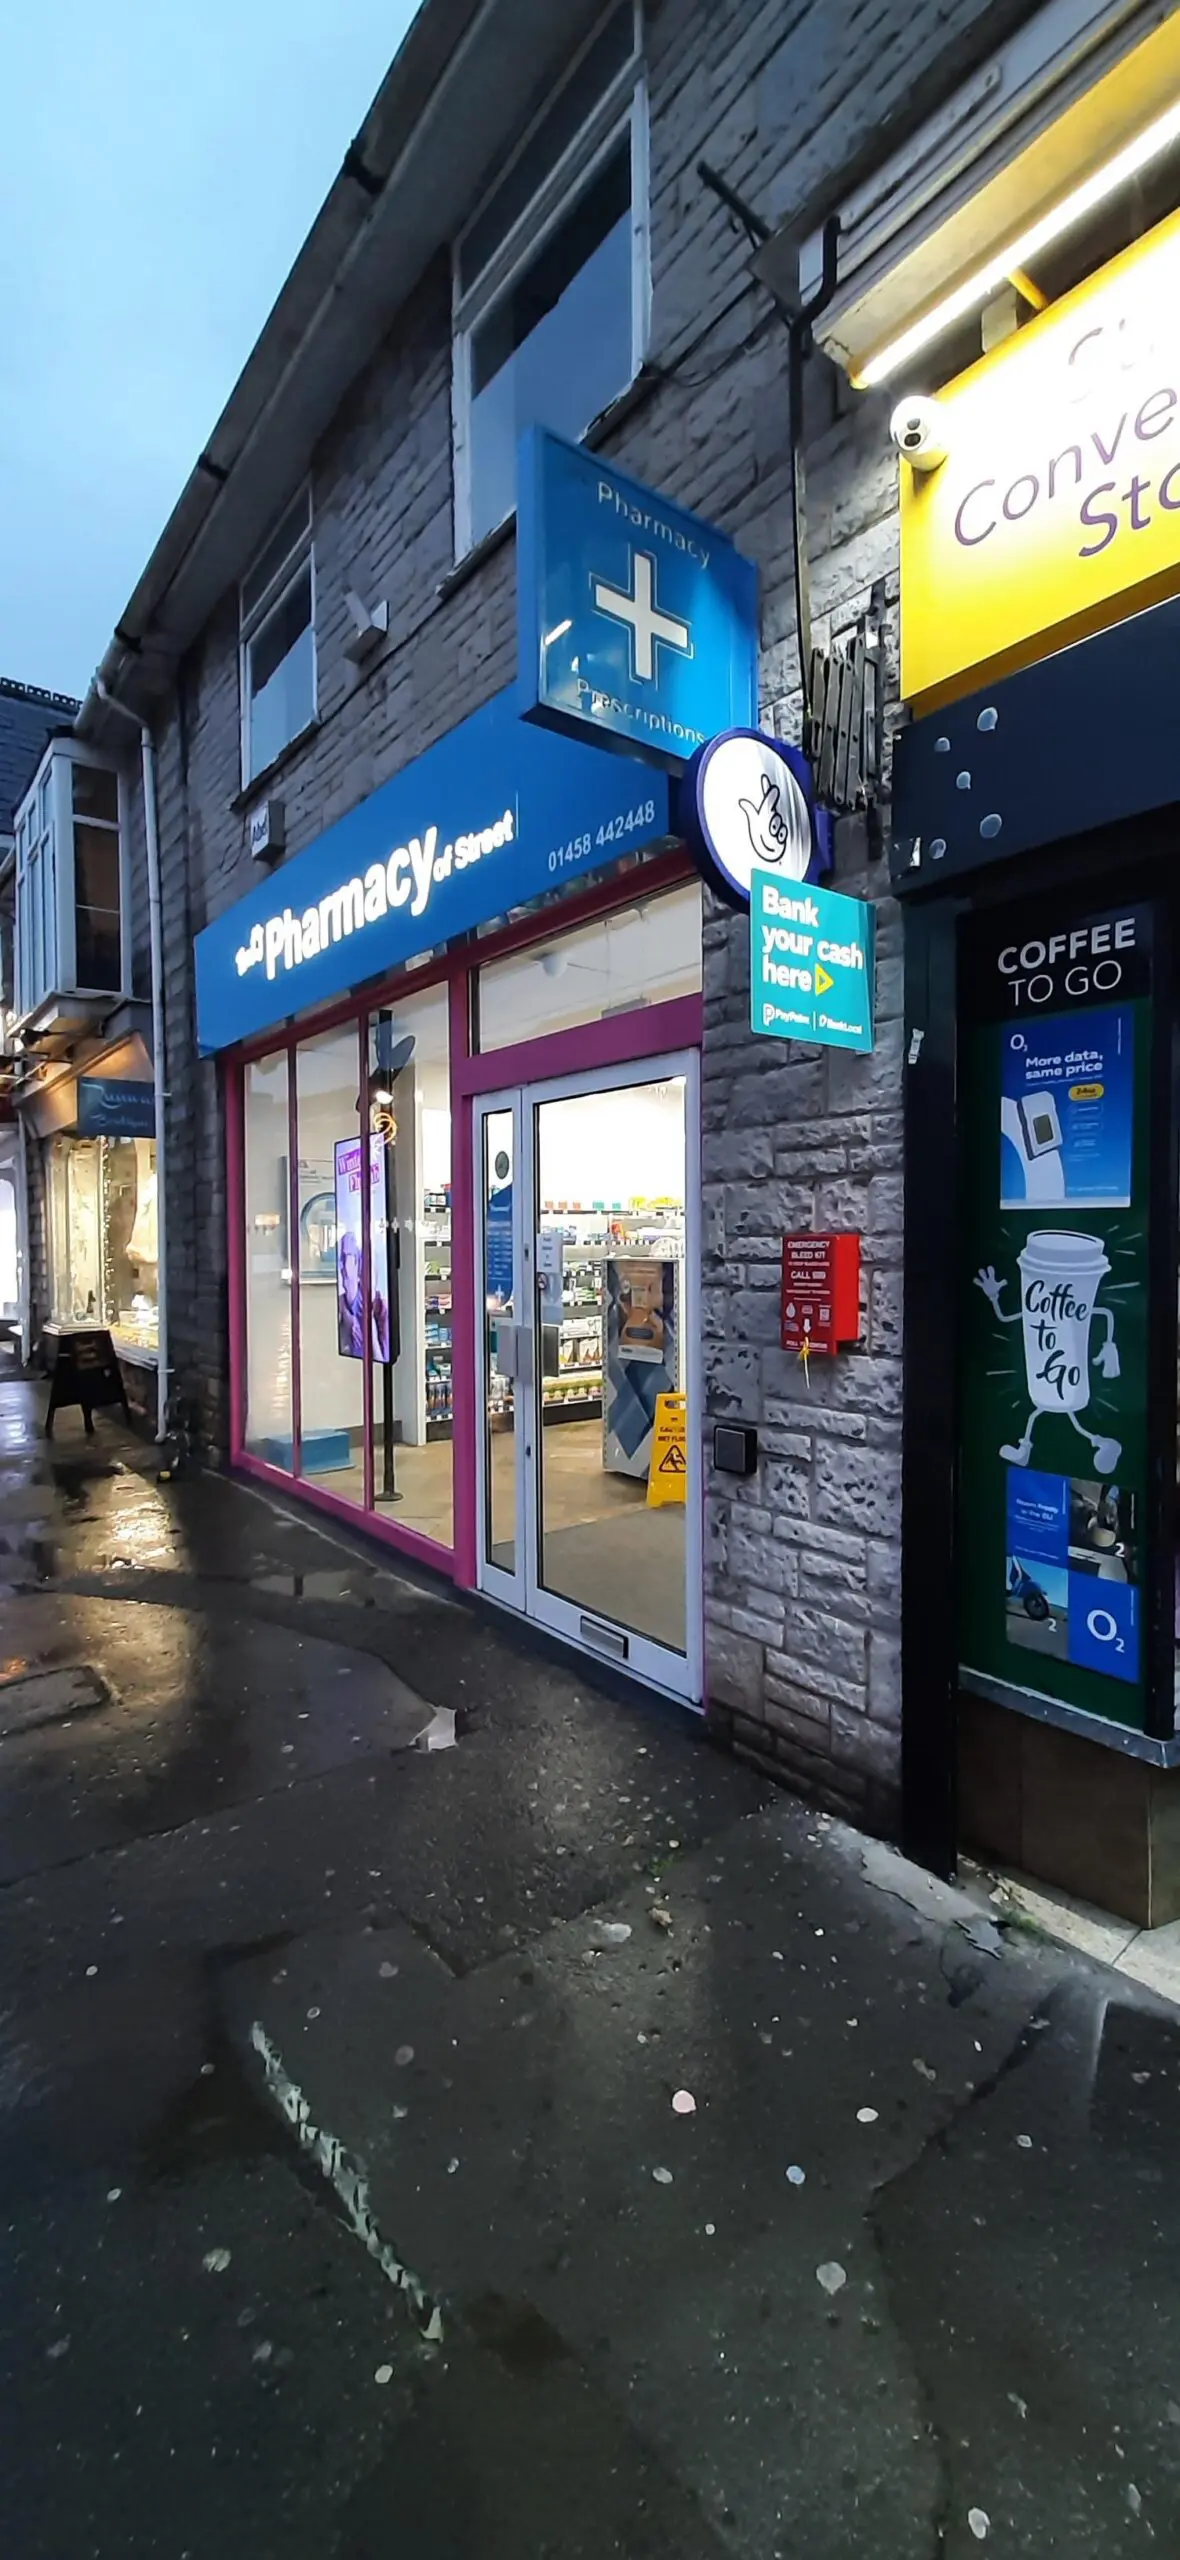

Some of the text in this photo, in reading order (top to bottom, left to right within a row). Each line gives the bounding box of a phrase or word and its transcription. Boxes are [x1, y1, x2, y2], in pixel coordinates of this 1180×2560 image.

[597, 481, 710, 569] Pharmacy
[576, 678, 704, 746] Prescriptions
[548, 799, 656, 873] 01458 442448
[265, 826, 438, 981] Pharmacy
[433, 845, 453, 883] of
[454, 808, 515, 870] Street
[761, 884, 819, 928] Bank
[761, 924, 864, 969] your cash
[997, 917, 1136, 975] COFFEE
[762, 953, 813, 993] here
[1008, 959, 1123, 1007] TO GO
[1025, 1049, 1104, 1069] More data,
[1025, 1066, 1063, 1081] same
[1065, 1061, 1104, 1078] price
[790, 1270, 811, 1280] CALL
[1025, 1279, 1089, 1322] Coffee
[1029, 1318, 1057, 1351] to
[1035, 1349, 1081, 1401] Go
